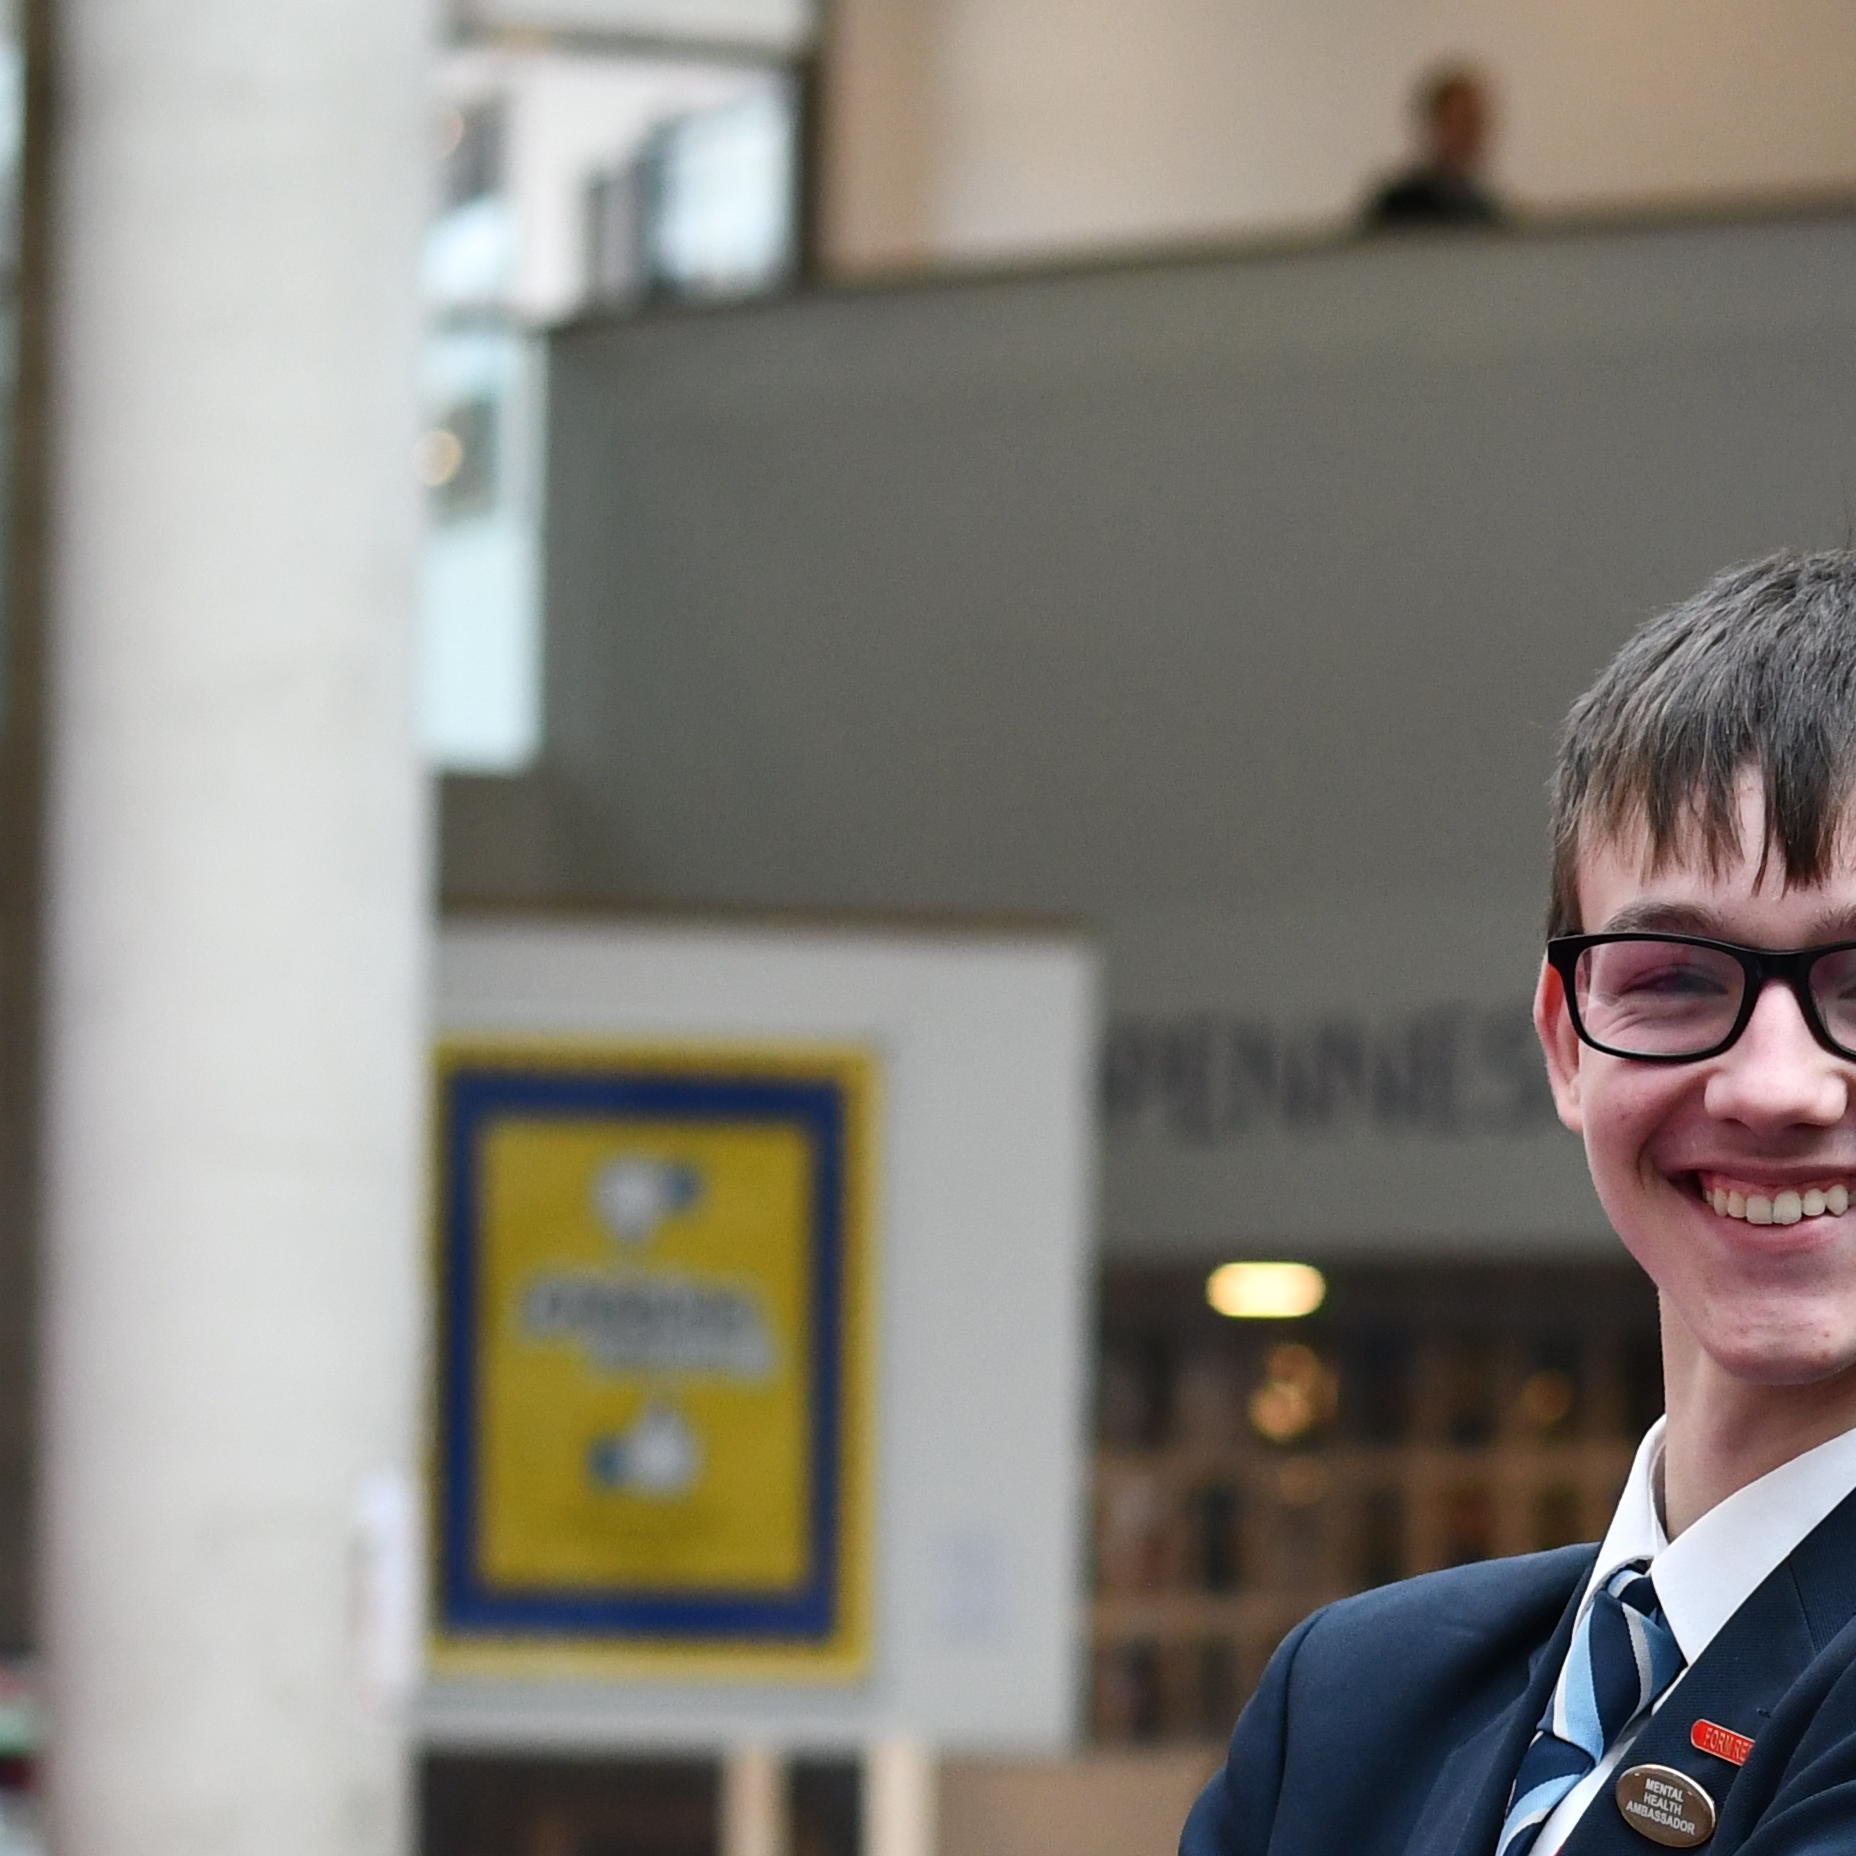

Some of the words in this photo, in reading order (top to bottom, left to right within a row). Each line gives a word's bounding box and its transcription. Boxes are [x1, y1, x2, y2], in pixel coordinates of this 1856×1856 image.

[1703, 1728, 1731, 1757] FORM
[1645, 1778, 1684, 1803] MENTAL
[1625, 1800, 1696, 1836] AMBASSADOR
[1643, 1793, 1683, 1816] HEALTH
